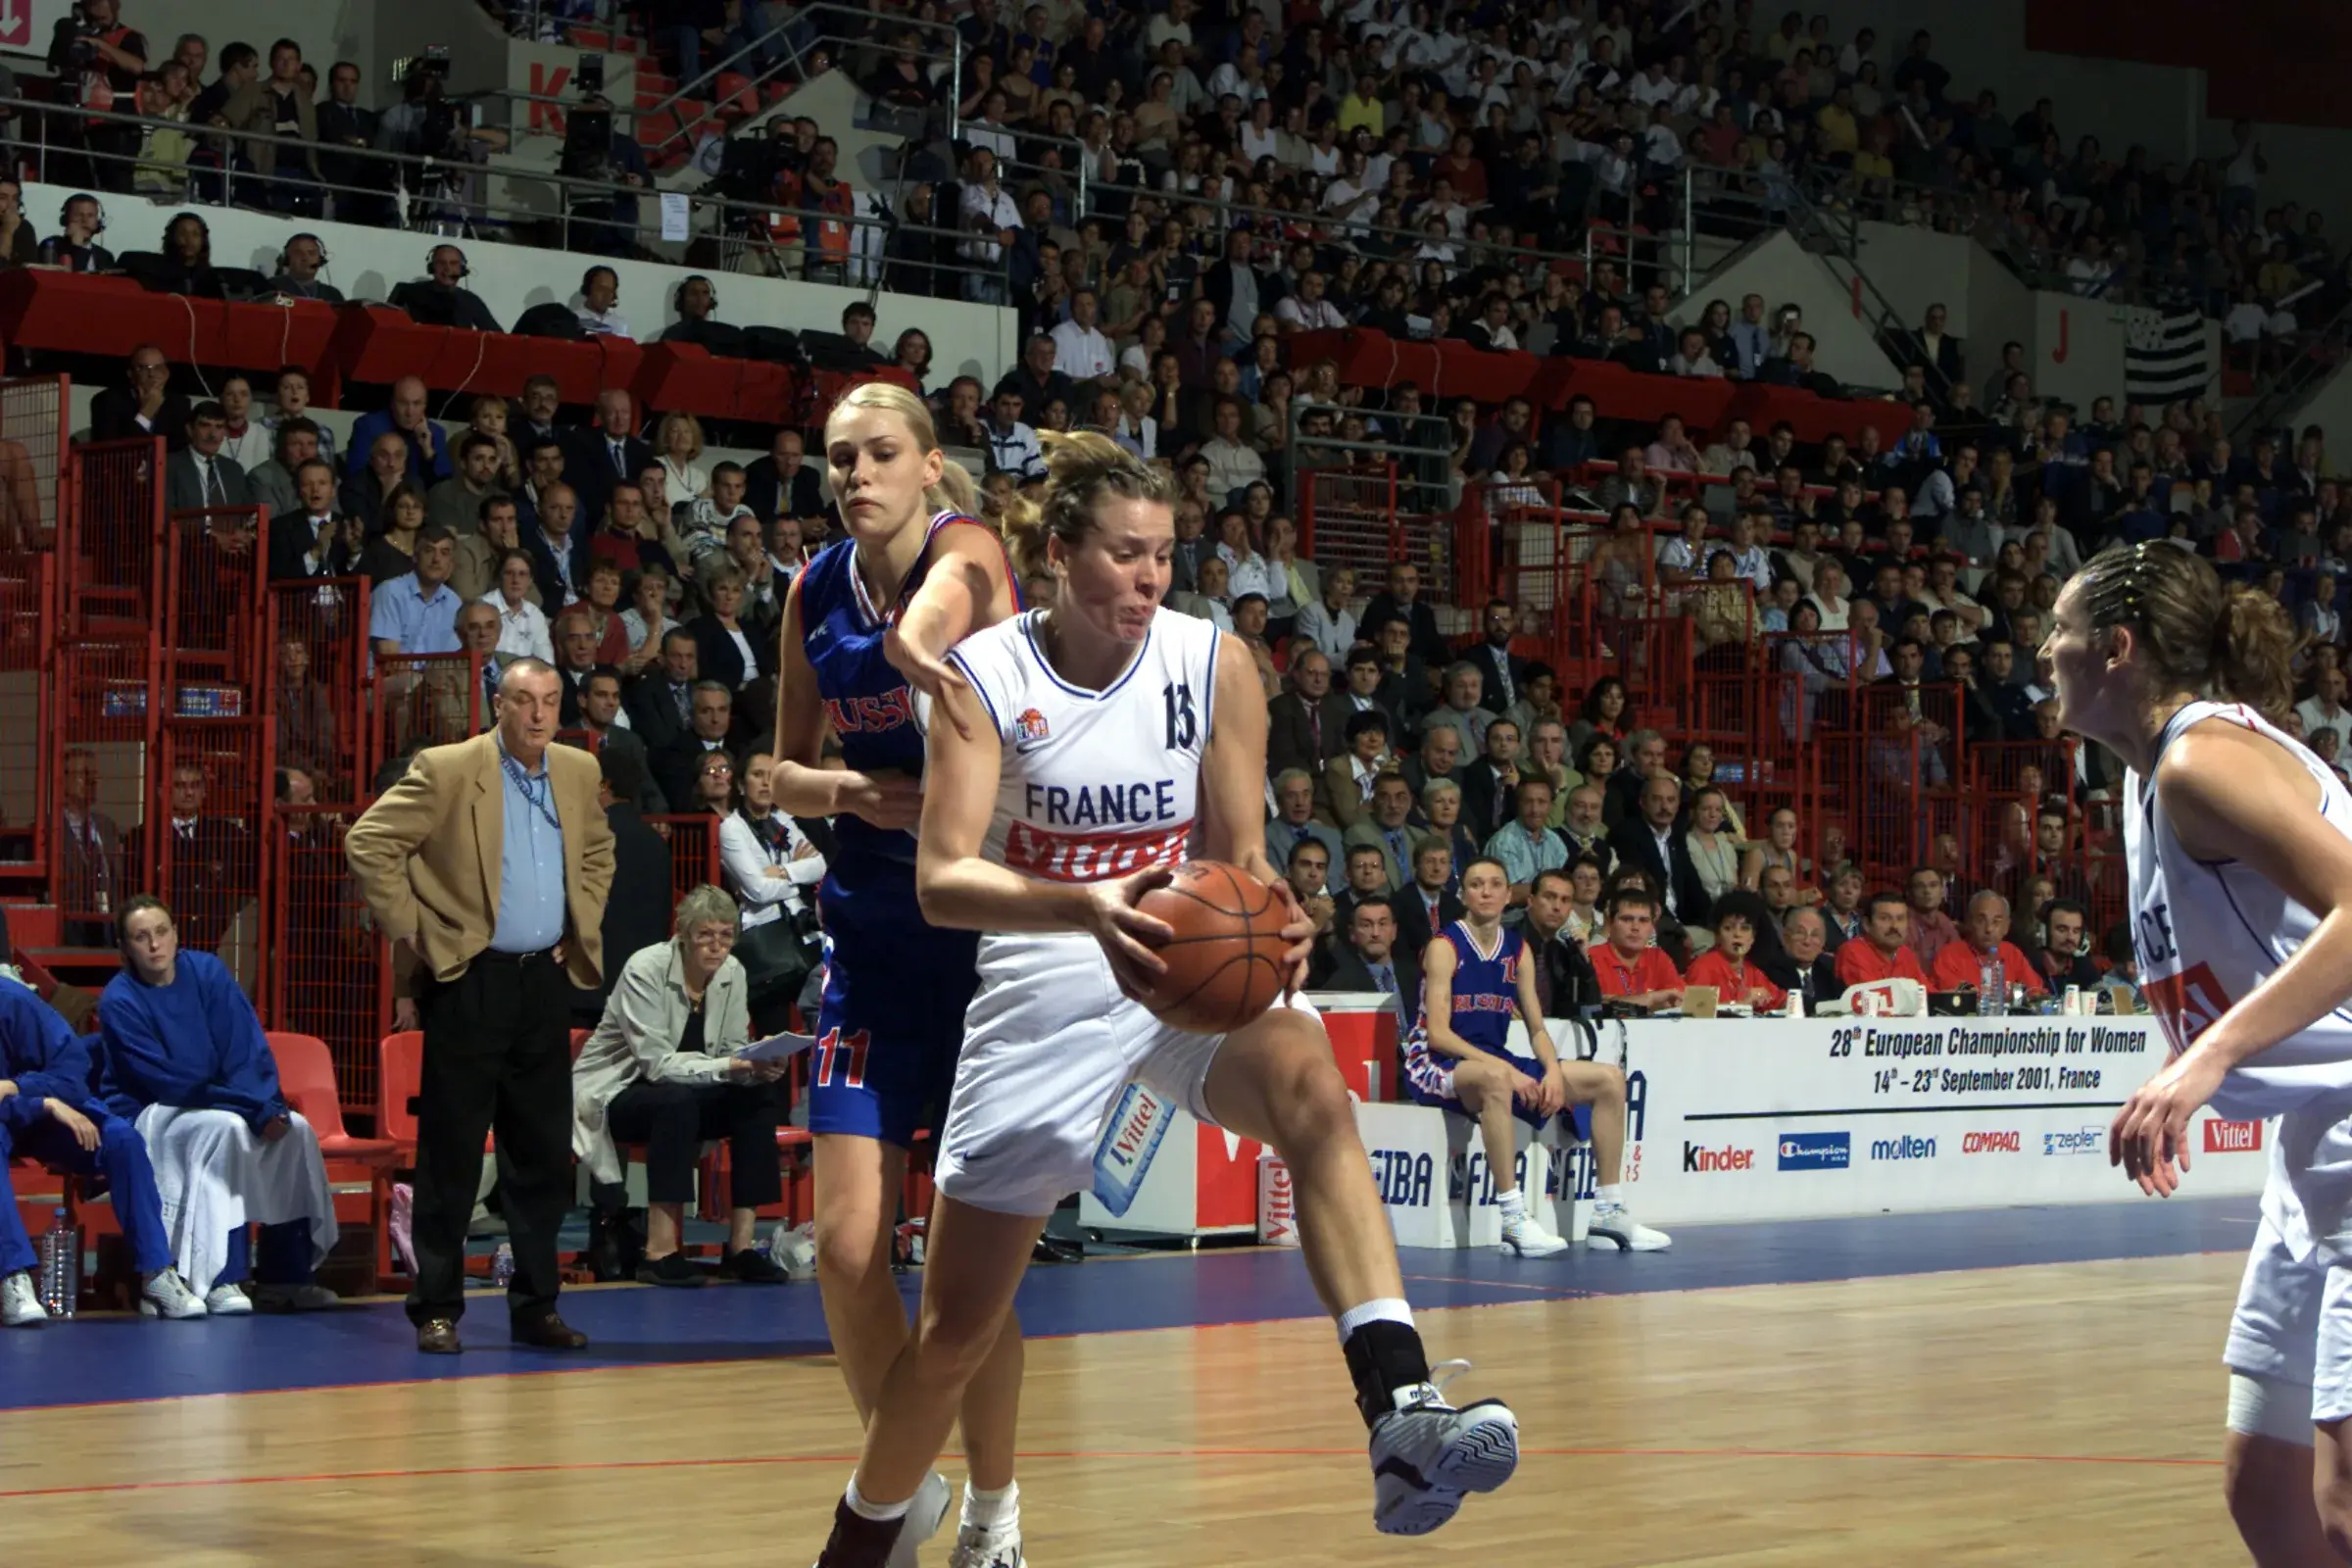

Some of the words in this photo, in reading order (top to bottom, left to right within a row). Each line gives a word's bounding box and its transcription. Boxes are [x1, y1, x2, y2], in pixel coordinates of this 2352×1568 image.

[530, 64, 571, 138] K
[2052, 309, 2069, 364] J
[1025, 779, 1176, 825] FRANCE
[818, 1026, 871, 1089] 11
[1864, 1028, 1943, 1059] European
[1947, 1026, 2060, 1057] Championship
[2065, 1028, 2087, 1054] for
[2090, 1027, 2147, 1054] Women
[1940, 1067, 2014, 1095] September
[2017, 1067, 2054, 1092] 2001,
[2058, 1067, 2101, 1090] France
[1116, 1092, 1157, 1153] Vittel
[2212, 1121, 2254, 1151] Vittel
[1780, 1141, 1849, 1161] Champion
[1871, 1135, 1936, 1160] molten
[1963, 1131, 2021, 1154] COMPAQ
[1266, 1161, 1292, 1240] Vittel
